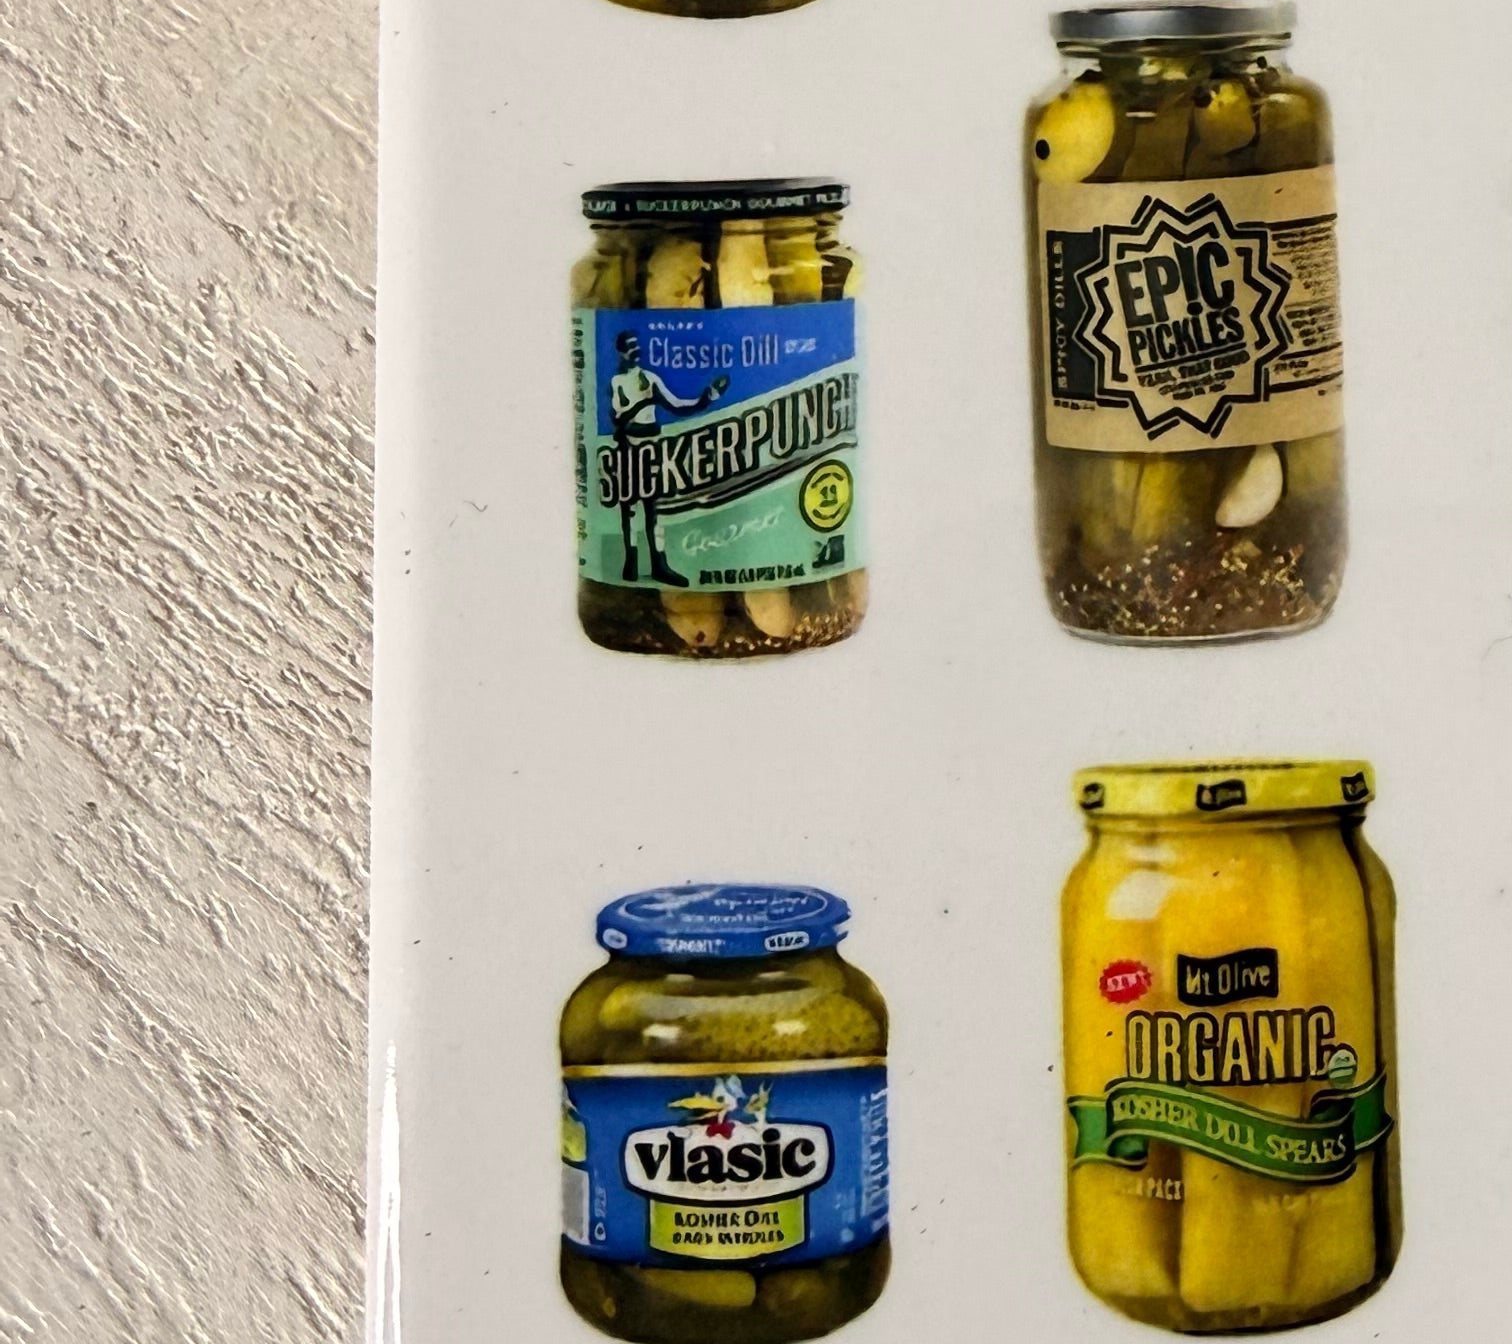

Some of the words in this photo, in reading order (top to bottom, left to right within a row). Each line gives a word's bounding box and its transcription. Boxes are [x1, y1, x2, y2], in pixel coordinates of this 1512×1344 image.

[649, 337, 734, 369] Classic
[741, 334, 779, 368] Dill
[1128, 306, 1246, 366] PICKLES
[597, 373, 859, 507] SUCKERPUNCH
[1127, 1009, 1333, 1083] ORGANIC
[634, 1128, 816, 1184] vlasic
